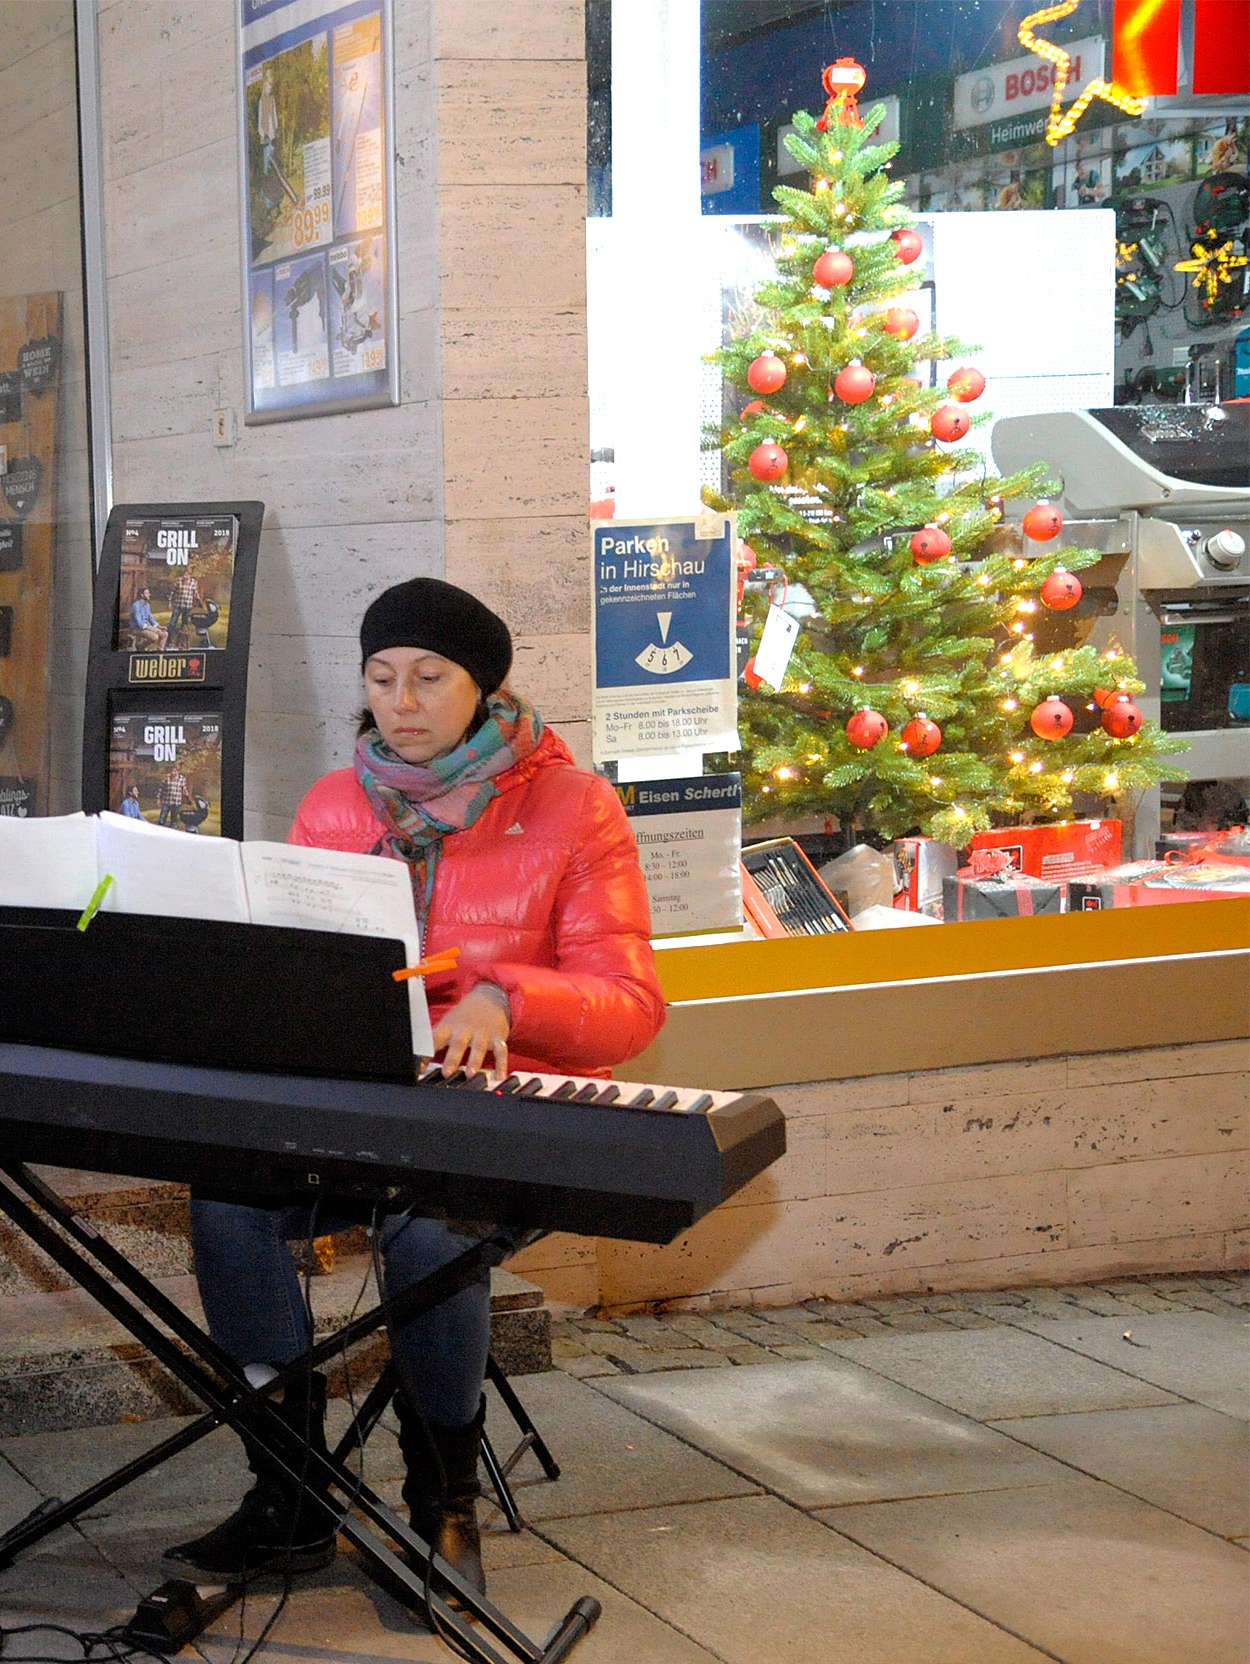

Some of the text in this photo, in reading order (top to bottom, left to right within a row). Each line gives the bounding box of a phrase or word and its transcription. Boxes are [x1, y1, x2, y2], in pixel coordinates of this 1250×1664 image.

[991, 118, 1049, 143] Heimwer
[22, 348, 51, 362] HOME
[157, 530, 199, 548] GRILL
[601, 535, 669, 556] Parken
[166, 548, 189, 565] ON
[601, 556, 705, 579] in Hirschau
[609, 583, 622, 592] der
[667, 582, 681, 590] nur
[600, 590, 697, 606] gekennzeichneten Flächen
[135, 655, 187, 679] weber
[661, 654, 668, 666] 6
[613, 711, 650, 720] Stunden
[652, 708, 665, 717] mit
[667, 705, 719, 716] Parkscheibe
[638, 721, 656, 730] 8.00
[657, 719, 670, 728] bis
[672, 717, 692, 726] 18.00
[694, 716, 708, 725] Uhr
[144, 726, 186, 744] GRILL
[605, 727, 708, 743] Sa 8.00 bis 13.00 Uhr
[154, 744, 176, 762] ON
[639, 791, 679, 804] Eisen
[636, 828, 705, 843] ffnungszeiten
[650, 851, 664, 859] Mo.
[668, 860, 688, 868] 12:00
[670, 871, 690, 880] 18:00
[652, 895, 681, 904] Samstag
[669, 904, 689, 912] 12:00
